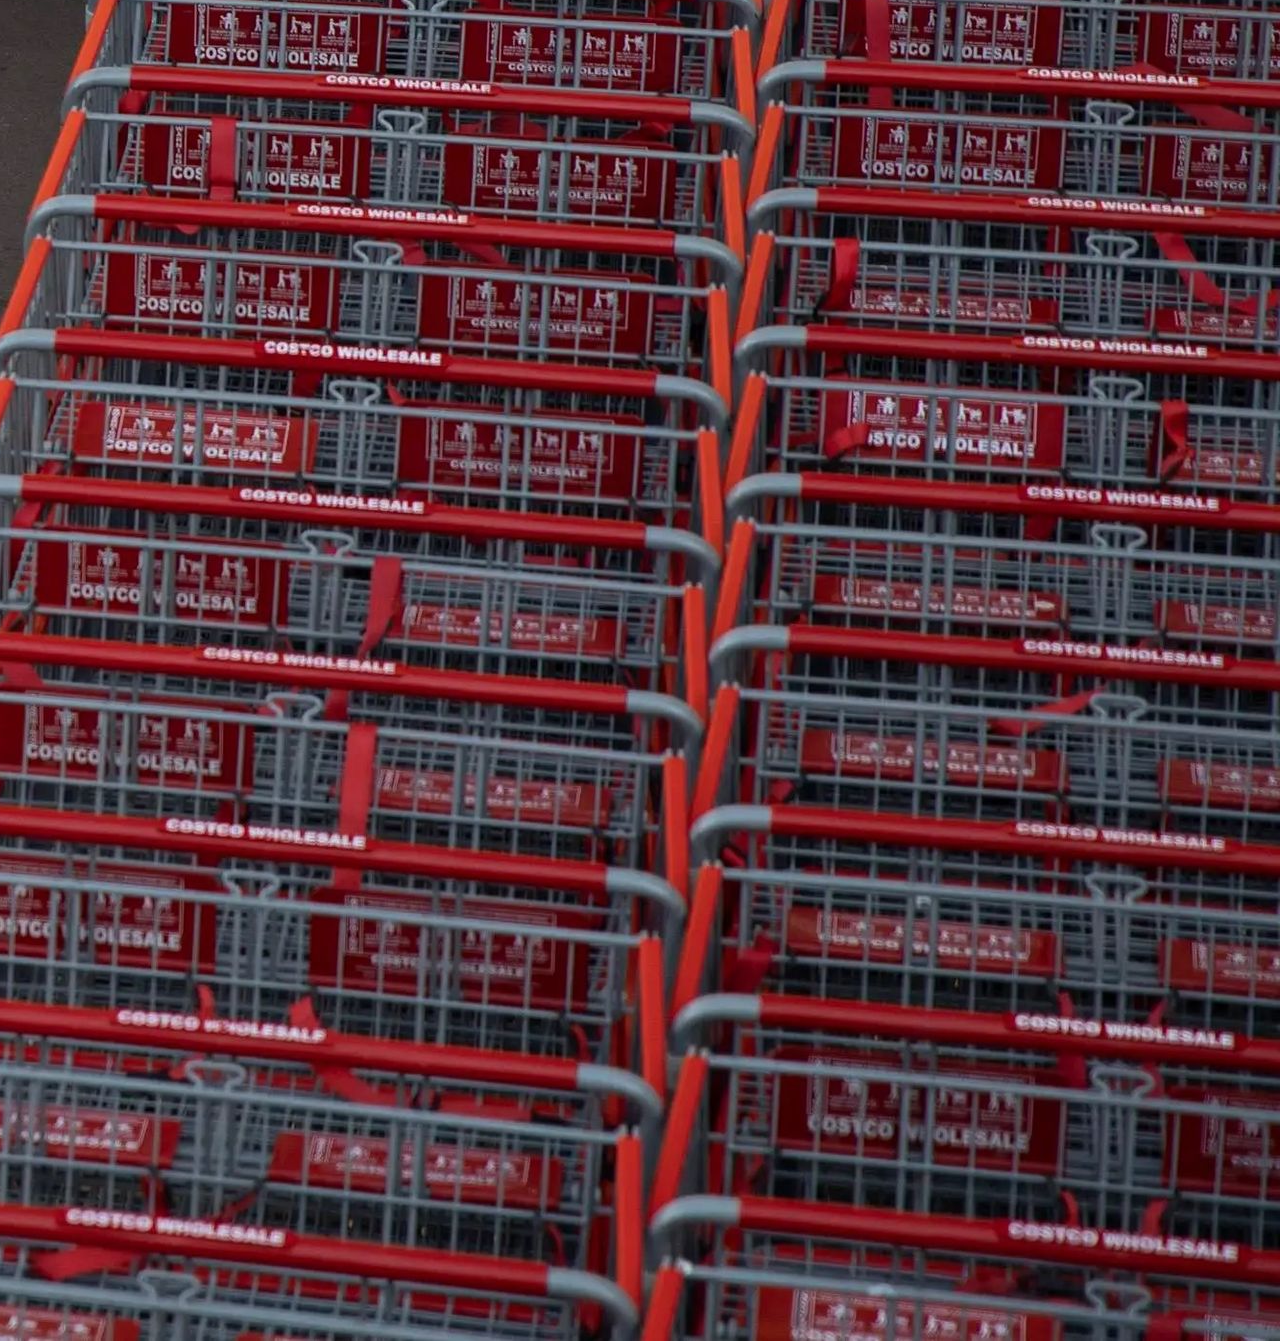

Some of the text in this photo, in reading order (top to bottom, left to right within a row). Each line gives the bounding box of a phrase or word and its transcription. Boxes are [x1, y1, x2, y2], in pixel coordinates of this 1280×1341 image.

[195, 46, 258, 62] COSTCO
[325, 74, 493, 93] COSTCO WHOLESALE
[1027, 68, 1199, 86] COSTCO WHOLESALE
[862, 160, 928, 178] COSTCO
[297, 204, 471, 224] COSTCO WHOLESALE
[1028, 197, 1205, 216] COSTCO WHOLESALE
[138, 296, 310, 322] COSTCO OLESALE
[264, 340, 442, 366] COSTCO WHOLESALE
[1023, 336, 1207, 357] COSTCO WHOLESALE
[240, 488, 424, 514] COSTCO WHOLESALE
[1027, 486, 1218, 509] COSTCO WHOLESALE
[203, 647, 395, 674] COSTCO WHOLESALE
[1024, 640, 1223, 666] COSTCO WHOLESALE
[166, 818, 366, 849] COSTCO WHOLESALE
[1016, 823, 1224, 850] COSTCO WHOLESALE
[1015, 1014, 1233, 1047] COSTCO WHOLESALE
[67, 1208, 284, 1245] COSTCO WHOLESALE
[1009, 1223, 1237, 1259] COSTCO WHOLESALE
